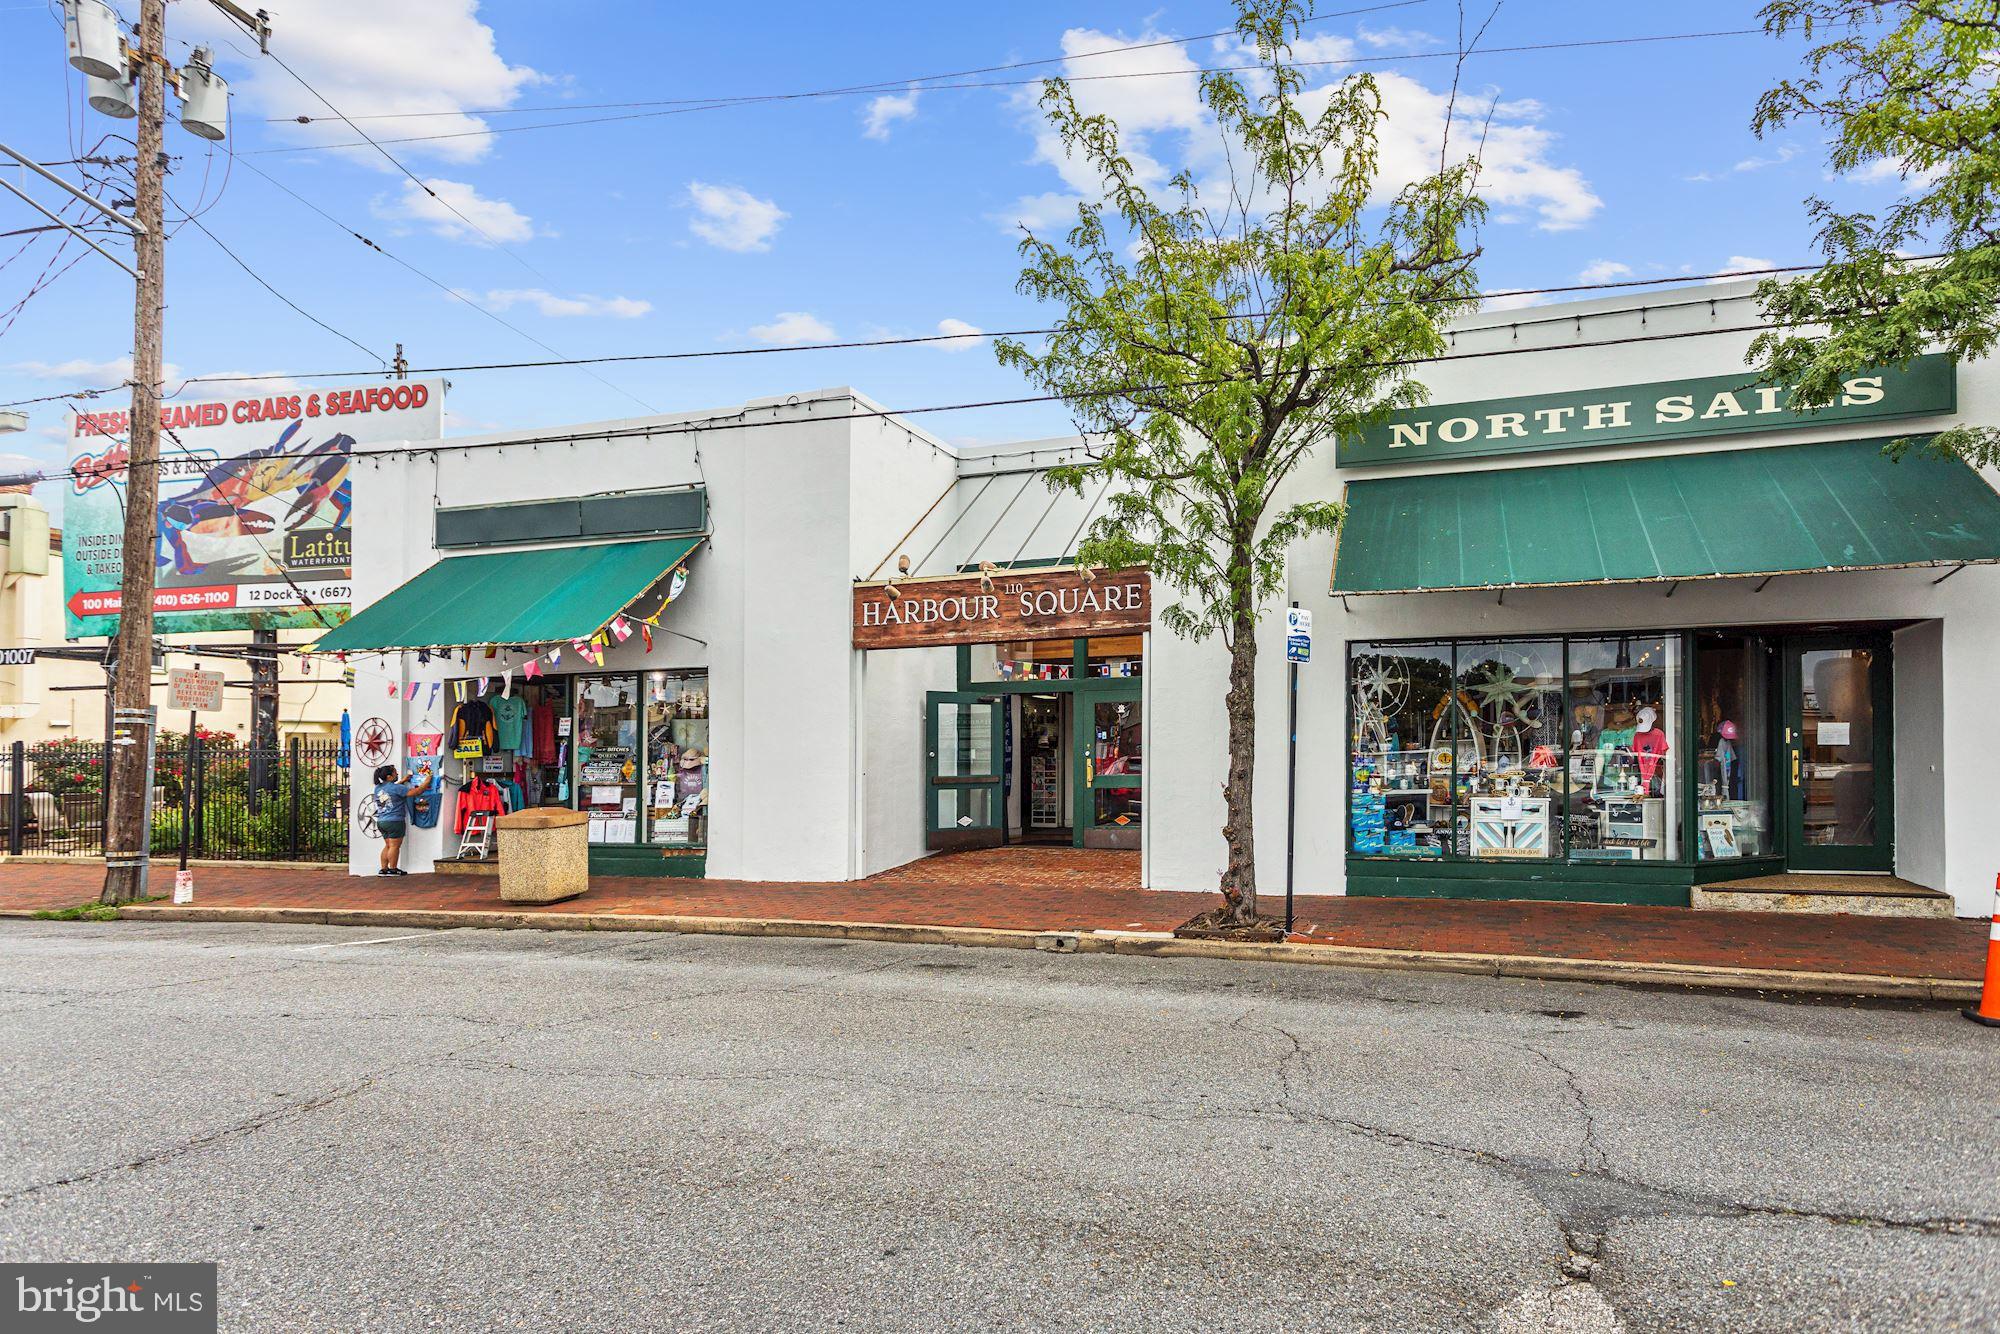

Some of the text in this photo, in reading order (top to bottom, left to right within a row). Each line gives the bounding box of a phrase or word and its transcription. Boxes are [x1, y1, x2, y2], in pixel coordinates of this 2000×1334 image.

[232, 395, 301, 424] CRABS
[306, 393, 321, 417] &
[325, 384, 428, 416] SEAFOOD
[1388, 376, 1886, 449] NORTH SAIS
[78, 532, 123, 547] INSIDE DIN
[290, 532, 352, 559] Latitu
[75, 549, 113, 562] OUTSIDE
[291, 556, 351, 566] WATERFRONT
[94, 562, 122, 574] TAKEO
[249, 590, 261, 600] 12
[264, 588, 293, 600] Dock
[320, 586, 352, 599] (667)
[1004, 583, 1023, 595] 110
[83, 598, 101, 609] 100
[103, 596, 122, 609] Mai
[179, 591, 230, 605] 626-1100
[862, 583, 1143, 626] HARBOUR SQUARE
[456, 745, 481, 753] SALE
